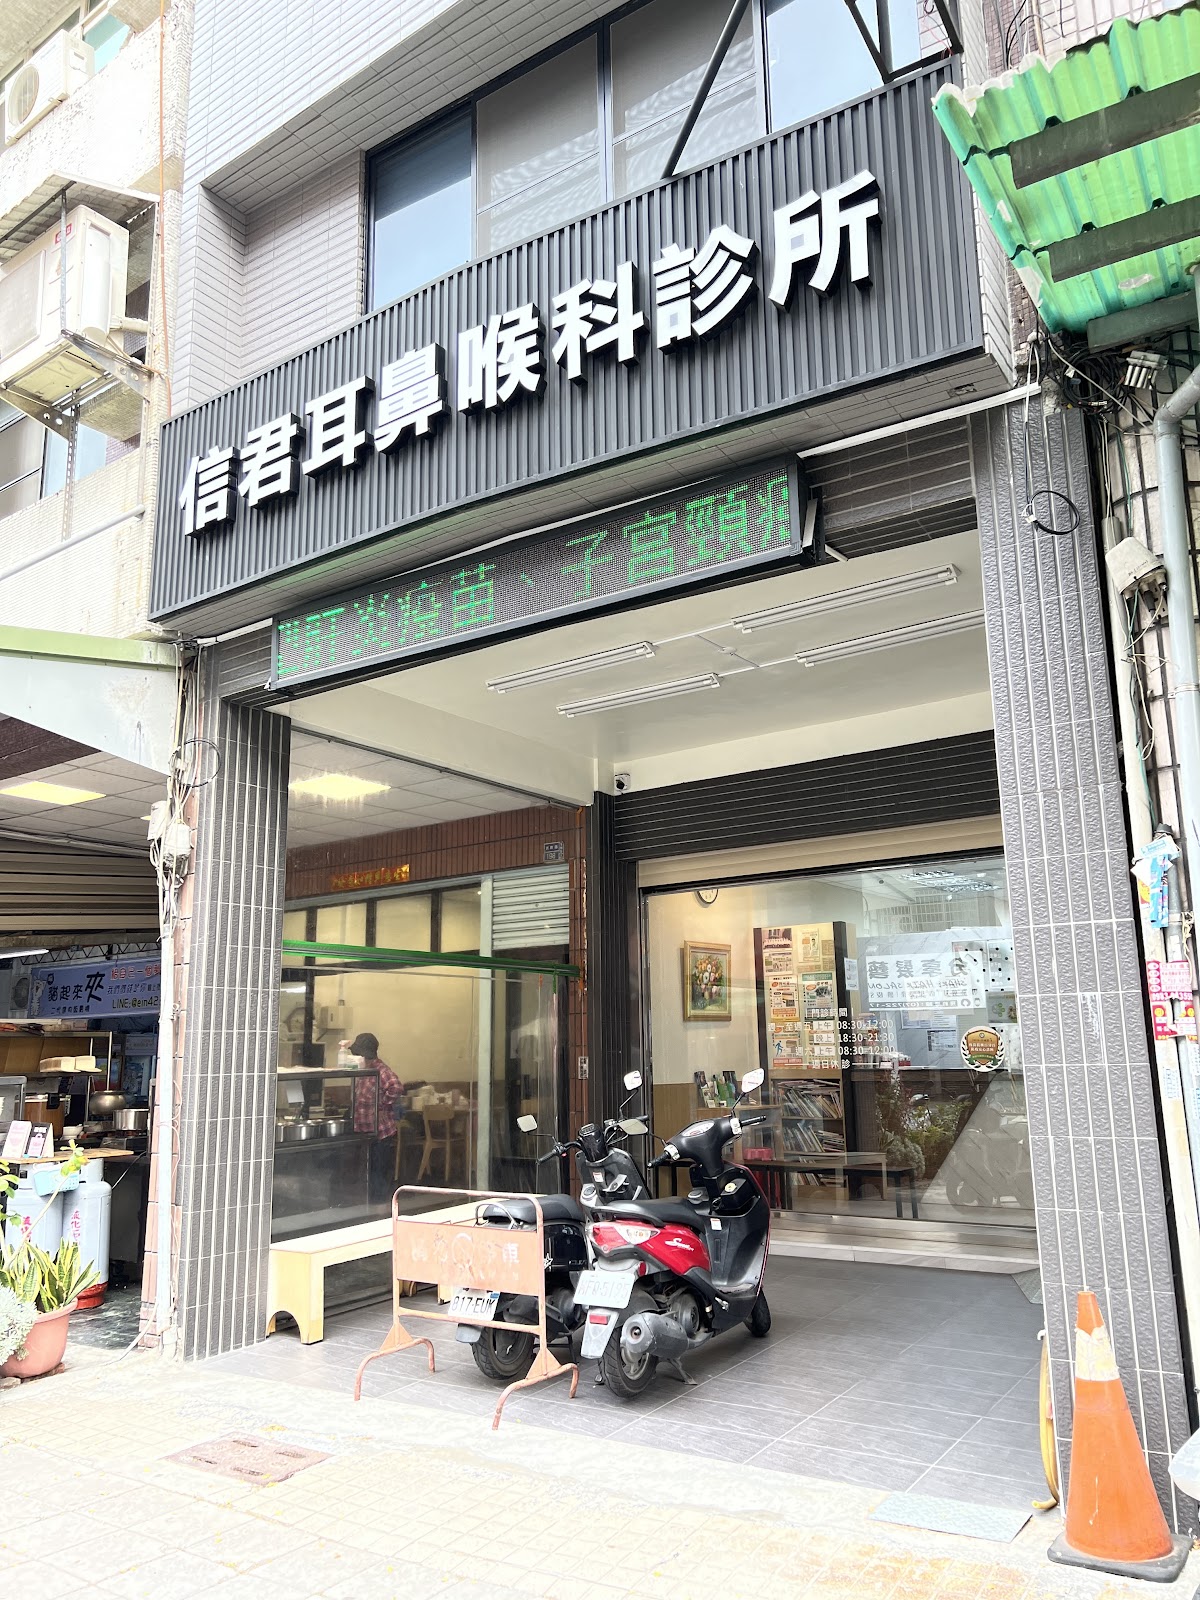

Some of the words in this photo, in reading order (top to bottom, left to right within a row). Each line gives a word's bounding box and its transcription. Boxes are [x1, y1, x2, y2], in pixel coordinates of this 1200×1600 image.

[179, 170, 881, 535] 信君耳鼻喉科診所
[837, 1019, 894, 1031] 08:30-12:00
[838, 1033, 895, 1043] 18:30-21:30
[838, 1045, 896, 1056] 08:30-12:00
